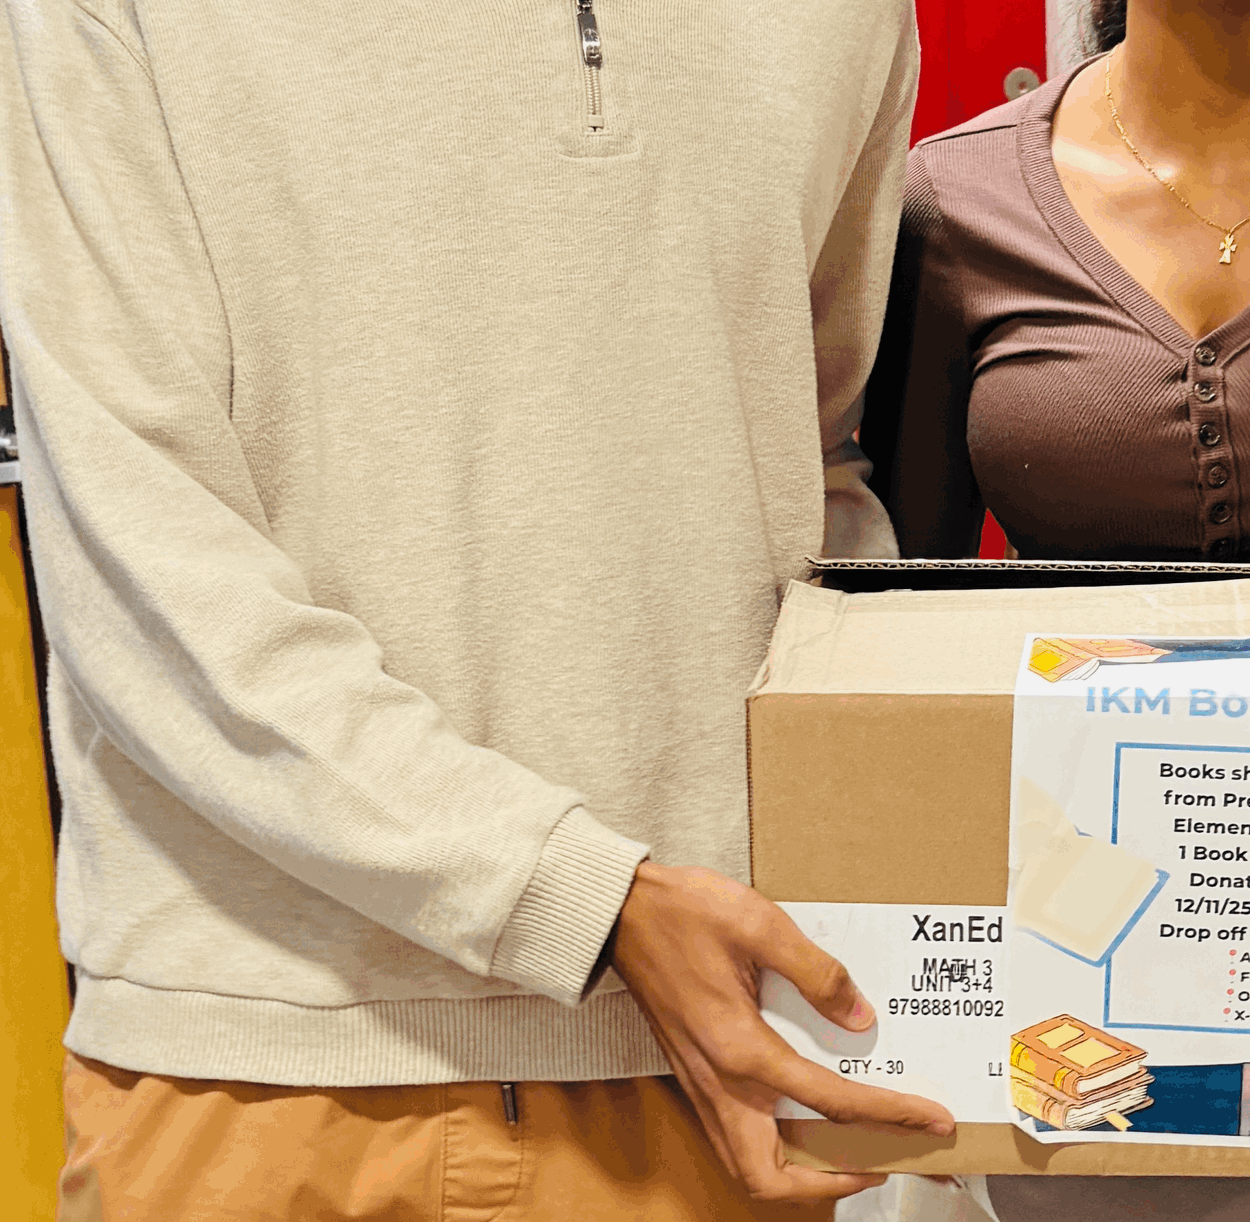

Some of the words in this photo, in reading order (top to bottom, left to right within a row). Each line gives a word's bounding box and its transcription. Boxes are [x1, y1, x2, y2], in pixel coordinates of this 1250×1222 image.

[1086, 687, 1170, 715] IKM
[1160, 763, 1225, 779] Books
[1164, 790, 1215, 806] from
[1179, 846, 1186, 859] 1
[1194, 846, 1247, 861] Book
[912, 914, 1003, 943] XanEd
[1160, 924, 1210, 942] Drop
[1218, 927, 1247, 940] off
[923, 957, 976, 977] MATH
[982, 959, 993, 977] 3
[911, 974, 955, 992] UNIT
[961, 976, 993, 994] 3+4
[888, 997, 1004, 1017] 97988810092
[838, 1059, 872, 1075] QTY
[886, 1059, 904, 1075] 30
